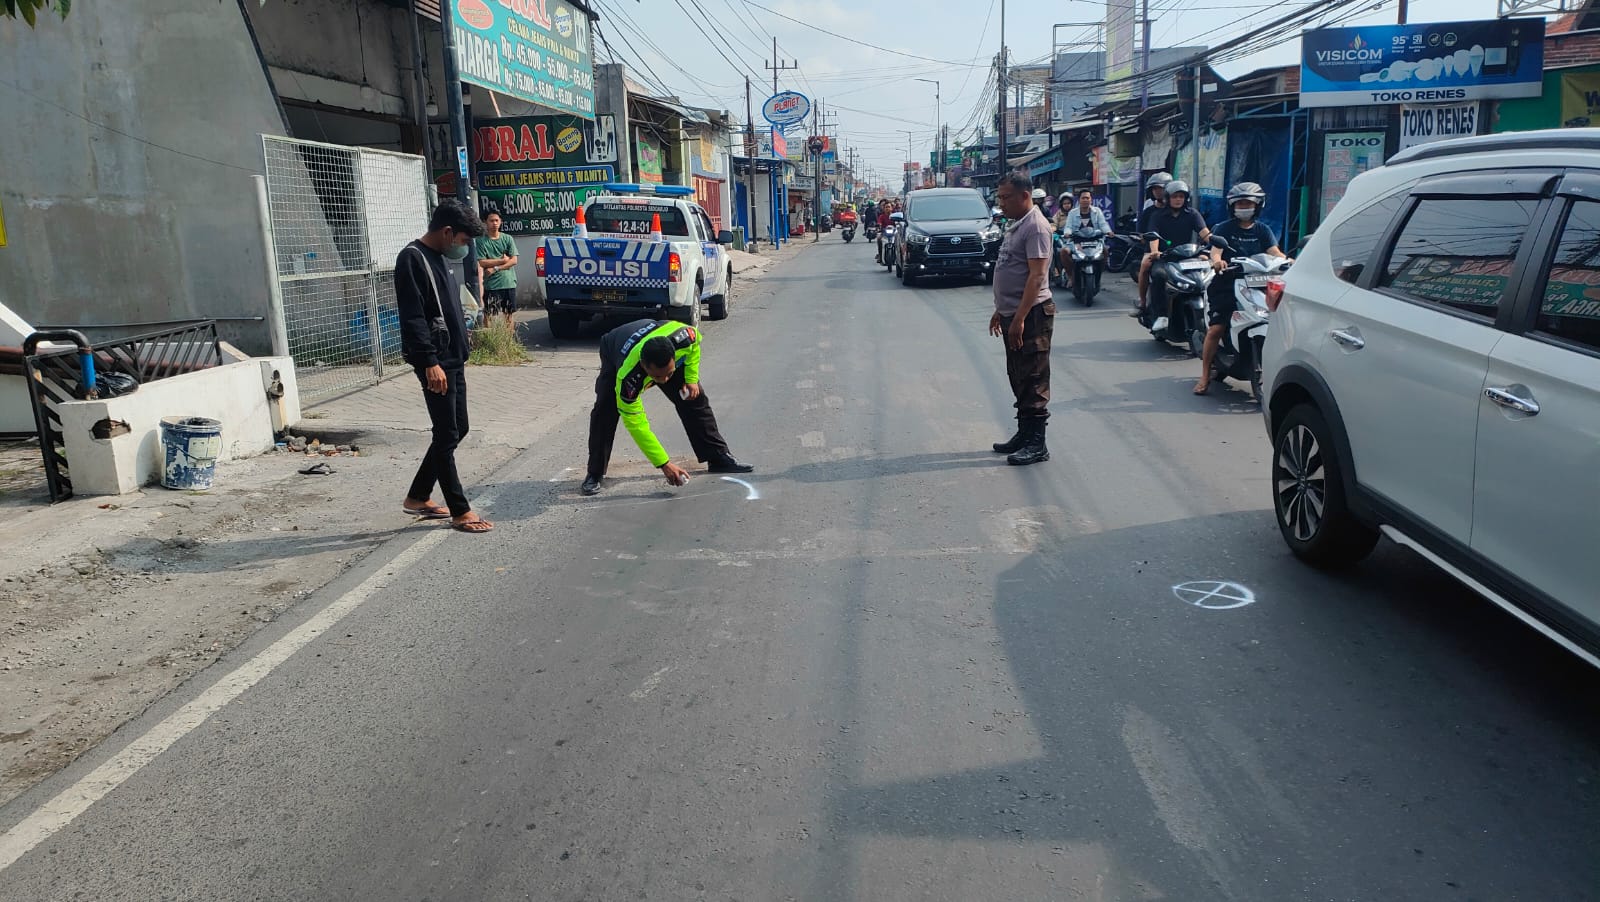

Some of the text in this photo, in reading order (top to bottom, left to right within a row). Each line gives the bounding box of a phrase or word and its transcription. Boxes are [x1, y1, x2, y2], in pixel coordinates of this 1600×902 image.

[456, 26, 502, 85] HARGA
[1316, 48, 1383, 62] VISICOM
[1371, 88, 1466, 102] TOKO RENES
[1403, 106, 1475, 137] TOKO RENES
[557, 128, 579, 145] Barang
[564, 138, 579, 150] Baru
[1328, 137, 1381, 148] TOKO
[484, 173, 516, 187] CELANA
[519, 172, 545, 186] JEANS
[546, 170, 566, 184] PRIA
[575, 169, 609, 183] WANITA
[503, 192, 535, 215] 45.000
[544, 190, 576, 213] 55.000
[530, 218, 554, 231] 85.000
[561, 217, 576, 229] 95.0
[562, 258, 649, 278] POLISI
[620, 322, 657, 356] POLISI
